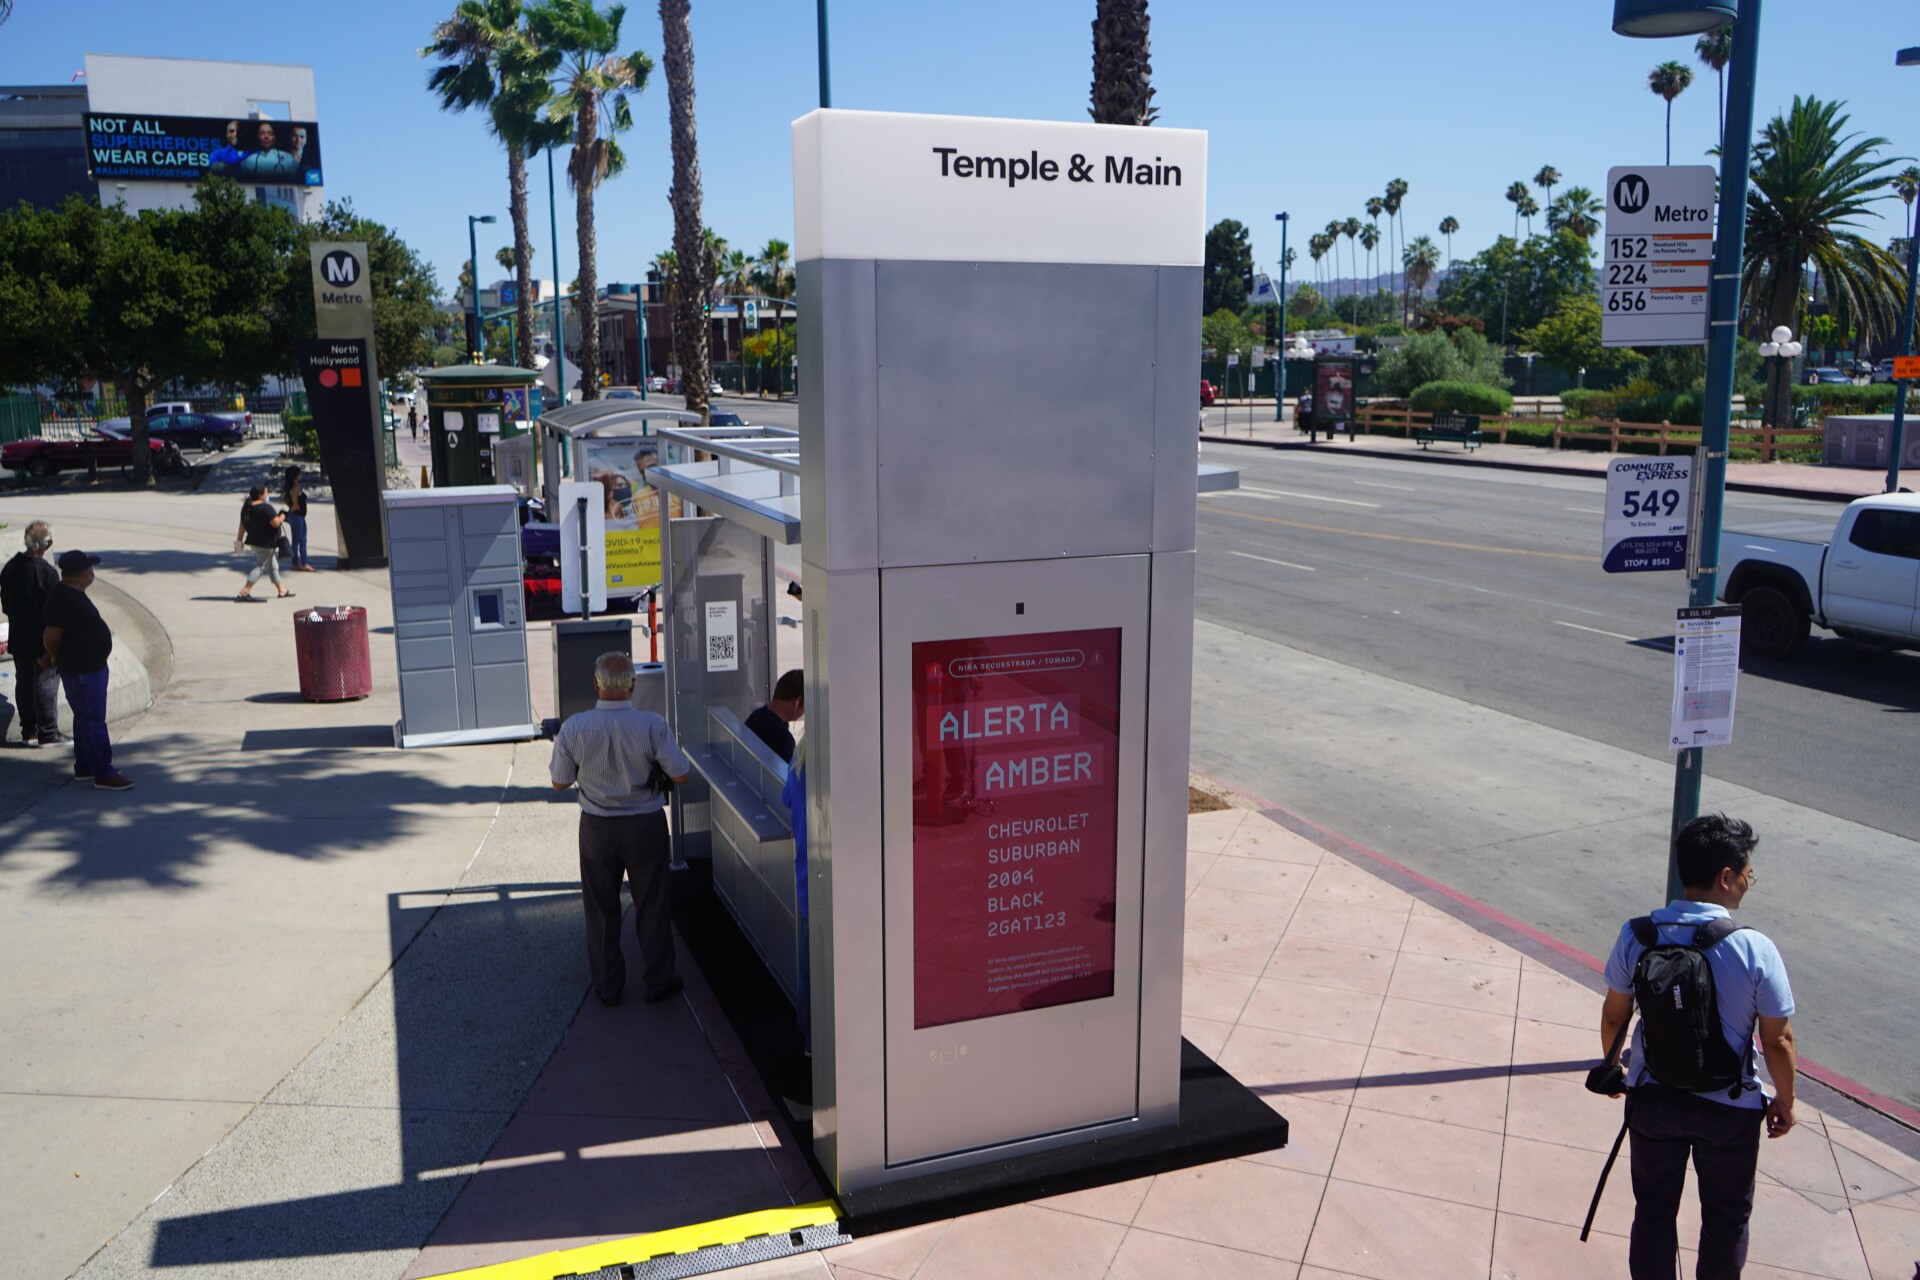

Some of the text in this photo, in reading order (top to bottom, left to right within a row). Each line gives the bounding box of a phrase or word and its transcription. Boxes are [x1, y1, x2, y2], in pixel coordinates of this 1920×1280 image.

[89, 118, 166, 135] NOT ALL
[91, 133, 221, 152] SUPERHEROES
[92, 148, 210, 167] WEAR CAPES
[932, 147, 1182, 188] Temple & Main
[1654, 205, 1708, 222] Metro
[1610, 238, 1648, 258] 152
[1609, 264, 1648, 285] 224
[322, 292, 364, 304] Metro
[1608, 290, 1647, 312] 656
[331, 345, 359, 354] North
[310, 356, 360, 366] Hollywood
[1616, 462, 1674, 472] COMMUTER
[1636, 470, 1689, 480] EXPRESS
[1622, 489, 1680, 518] 549
[1624, 559, 1648, 567] STOP#
[958, 662, 978, 672] NIÑA
[980, 659, 1036, 670] SECUESTRADA
[1045, 656, 1076, 664] TOMADA
[940, 701, 1069, 742] ALERTA
[986, 751, 1092, 791] AMBER
[988, 812, 1089, 840] CHEVROLET
[988, 838, 1080, 864] SUBURBAN
[988, 868, 1034, 889] 2004
[988, 891, 1044, 913] BLACK
[988, 911, 1066, 937] 2GAT123
[1673, 984, 1683, 1010] THULE
